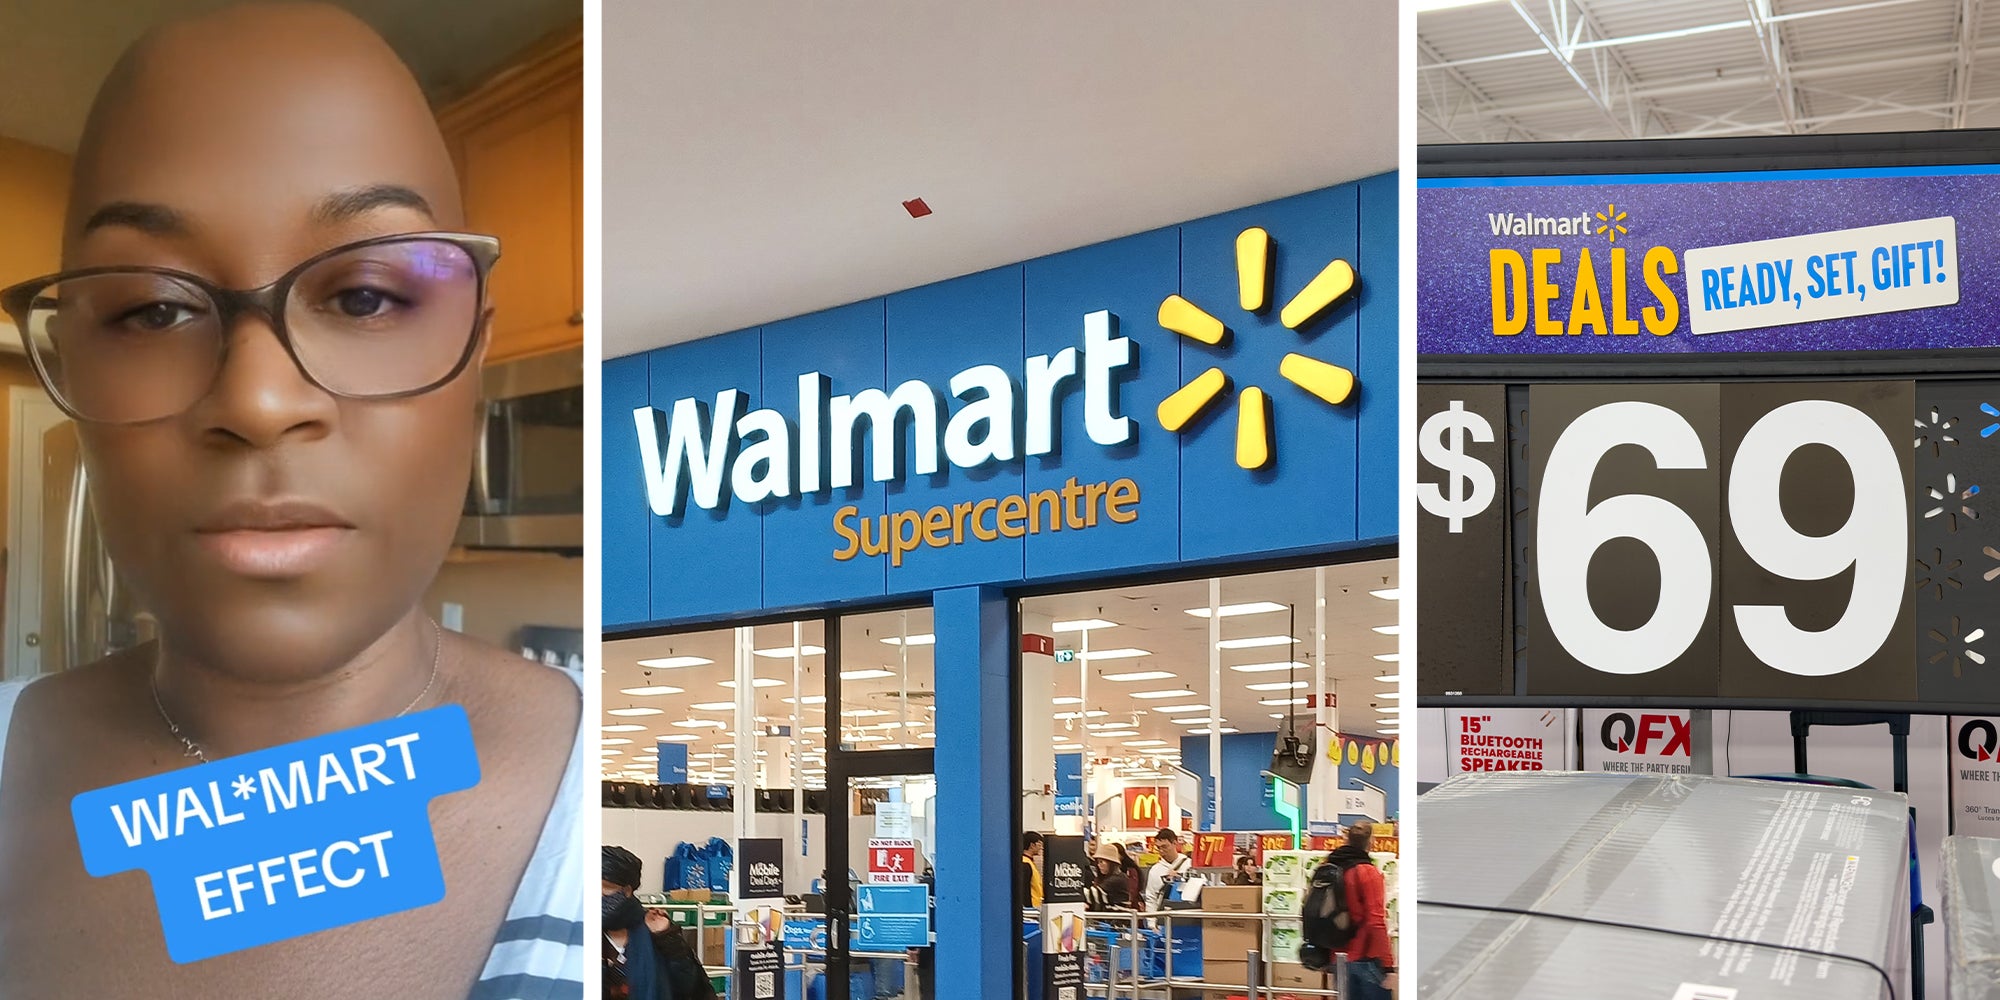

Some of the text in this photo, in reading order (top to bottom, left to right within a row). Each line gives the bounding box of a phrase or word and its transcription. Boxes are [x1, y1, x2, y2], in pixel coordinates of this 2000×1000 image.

[1489, 212, 1591, 237] Walmart
[1701, 239, 1947, 312] READY, SET, GIFT!
[1489, 246, 1679, 337] DEALS
[632, 309, 1138, 518] Walmart
[832, 476, 1140, 567] Supercentre
[1461, 715, 1491, 733] 15"
[1461, 734, 1543, 750] BLUETOOTH
[1600, 712, 1691, 757] QFX
[1957, 719, 2000, 763] Q
[1461, 747, 1543, 760] RECHARGEABLE
[1461, 757, 1543, 772] SPEAKER
[1602, 761, 1629, 773] WHERE
[1631, 762, 1644, 773] THE
[1646, 763, 1669, 774] PARTY
[1960, 770, 1989, 782] WHERE
[749, 862, 780, 876] Mobile
[1054, 862, 1082, 877] Mobile
